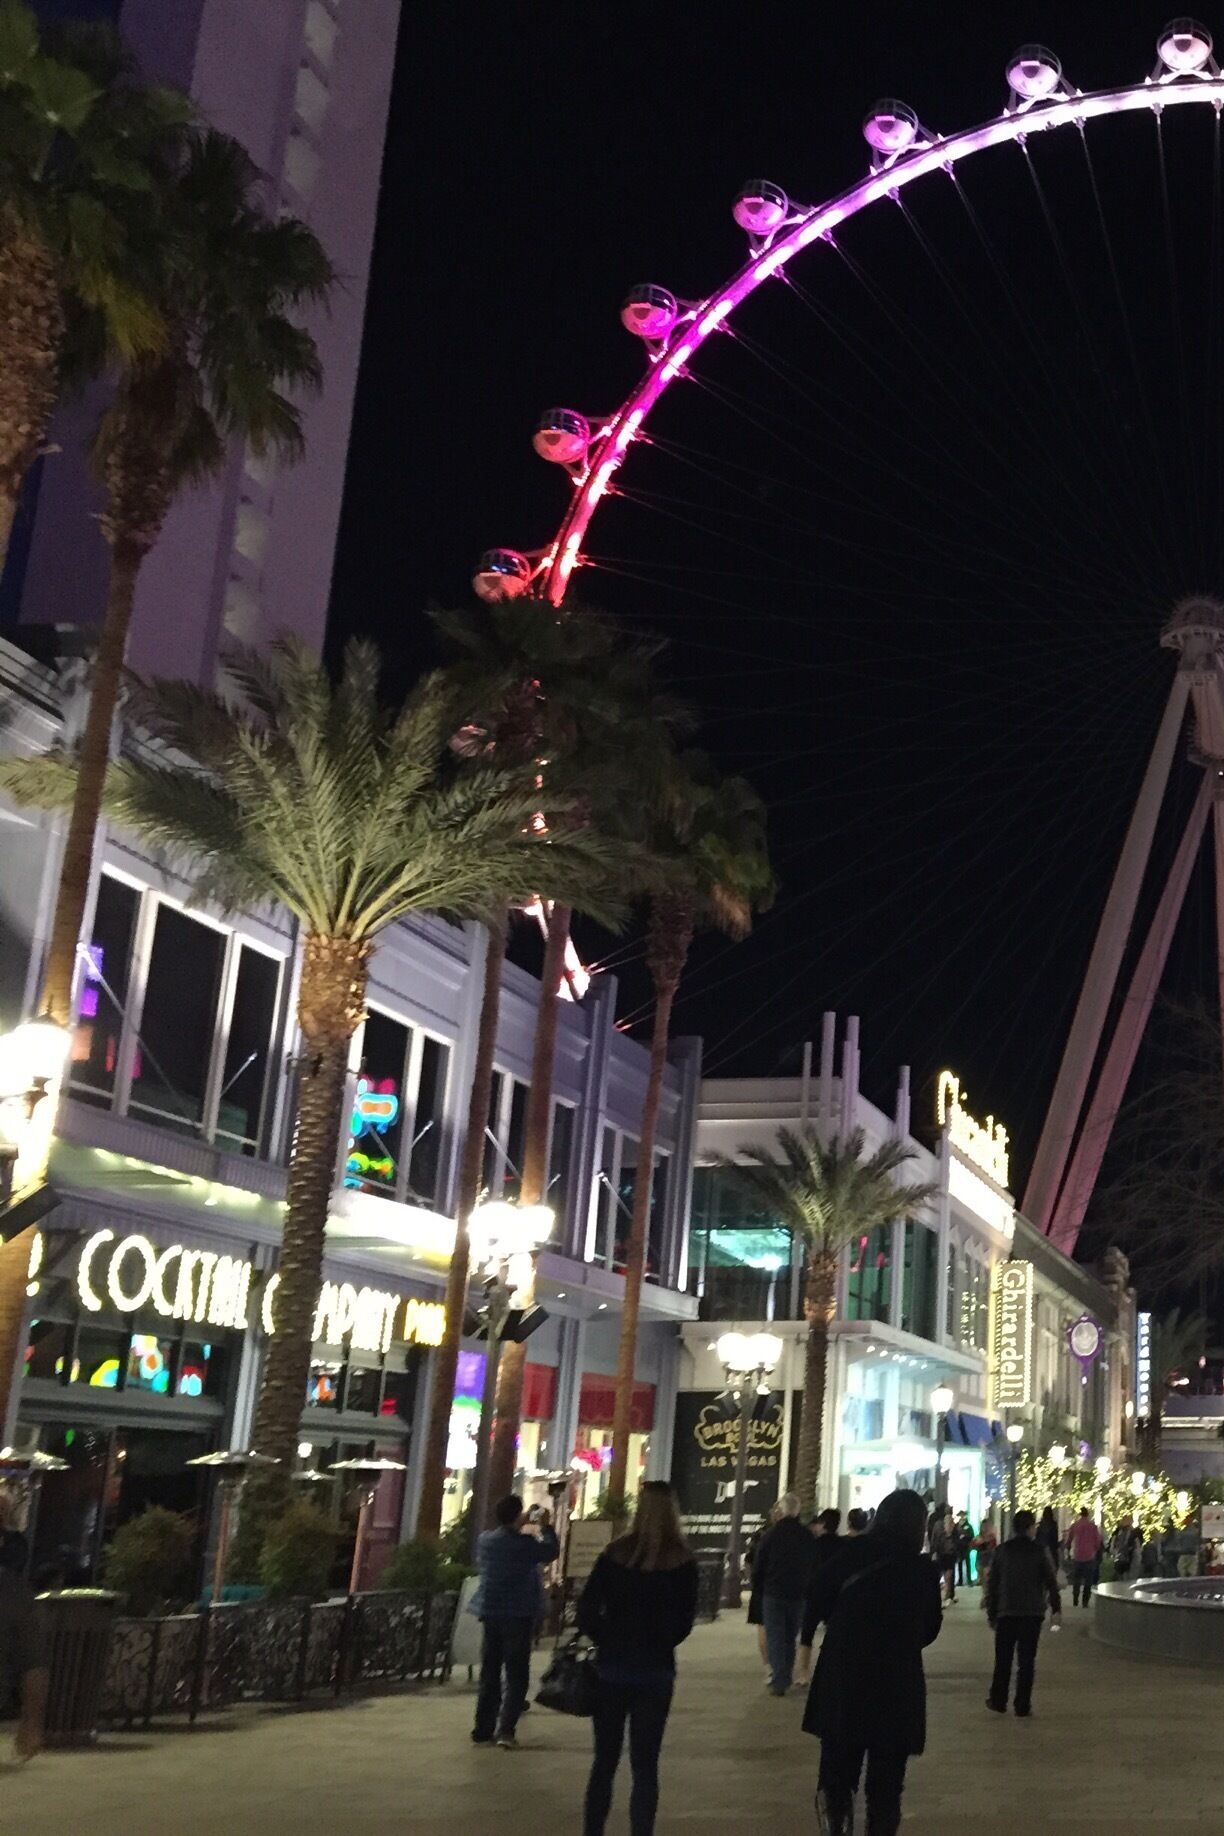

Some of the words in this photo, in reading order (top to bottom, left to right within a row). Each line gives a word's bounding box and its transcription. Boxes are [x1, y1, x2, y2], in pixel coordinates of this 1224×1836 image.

[77, 1228, 251, 1330] COCKTAIL
[1000, 1267, 1027, 1398] Ghirardelli
[700, 1455, 728, 1467] LAS
[731, 1455, 777, 1467] VGAS
